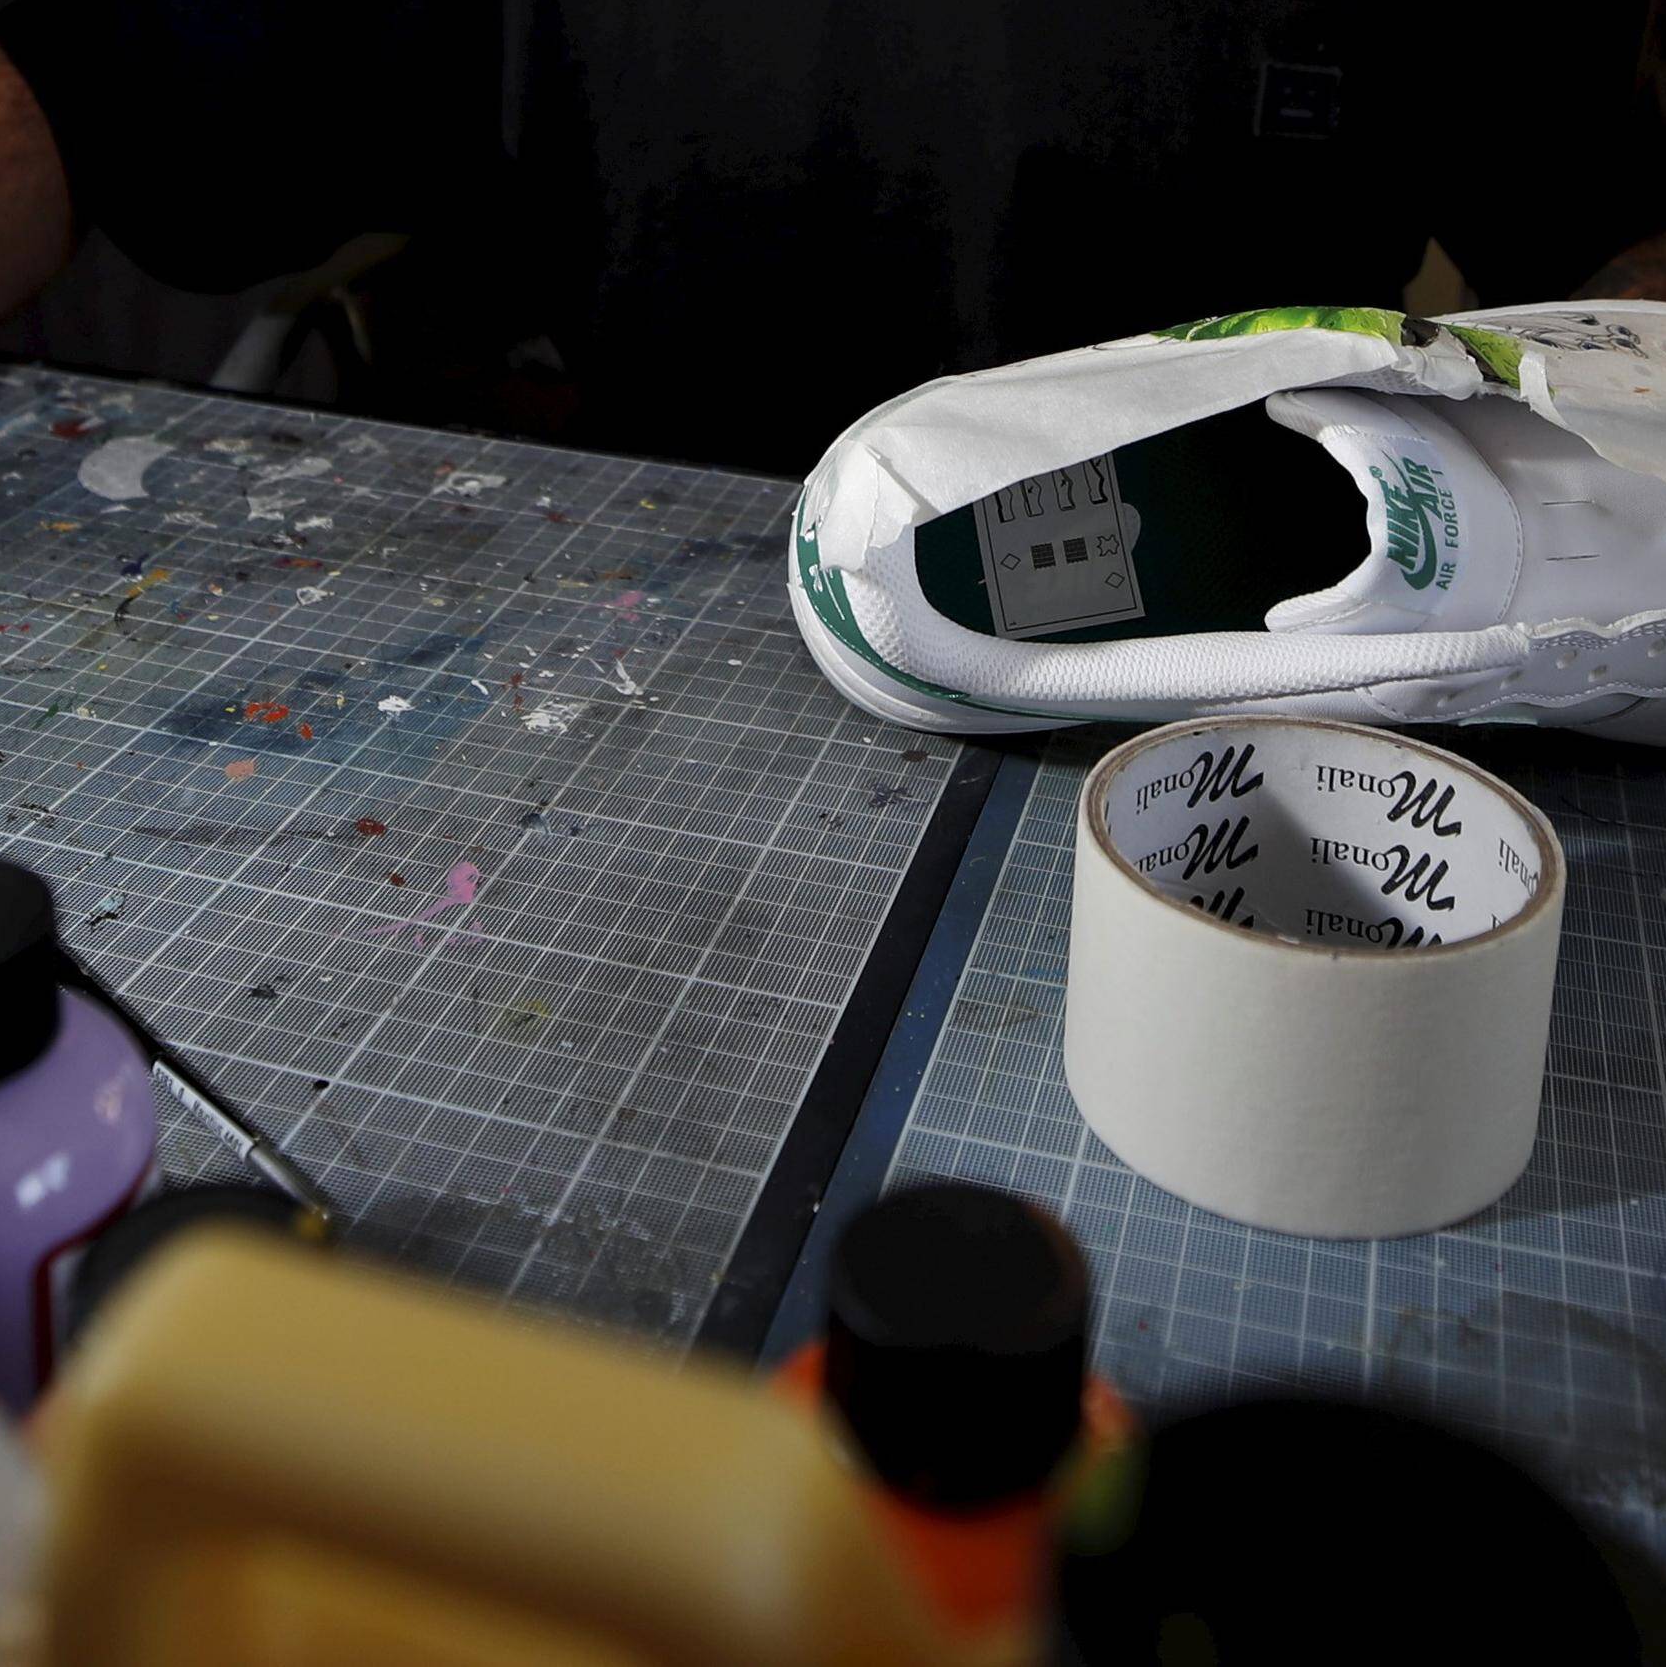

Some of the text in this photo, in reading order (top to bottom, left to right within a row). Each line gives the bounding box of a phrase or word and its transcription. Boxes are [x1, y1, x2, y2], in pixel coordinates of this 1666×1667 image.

[1402, 457, 1445, 521] AIR
[1441, 489, 1459, 549] FORCE
[1380, 478, 1421, 571] NIKE
[1436, 562, 1457, 590] AIR
[1136, 743, 1264, 815] Monali
[1316, 765, 1462, 837] Monali
[1134, 815, 1259, 880] Monal
[1309, 837, 1455, 911] Monali
[1499, 837, 1539, 897] onali
